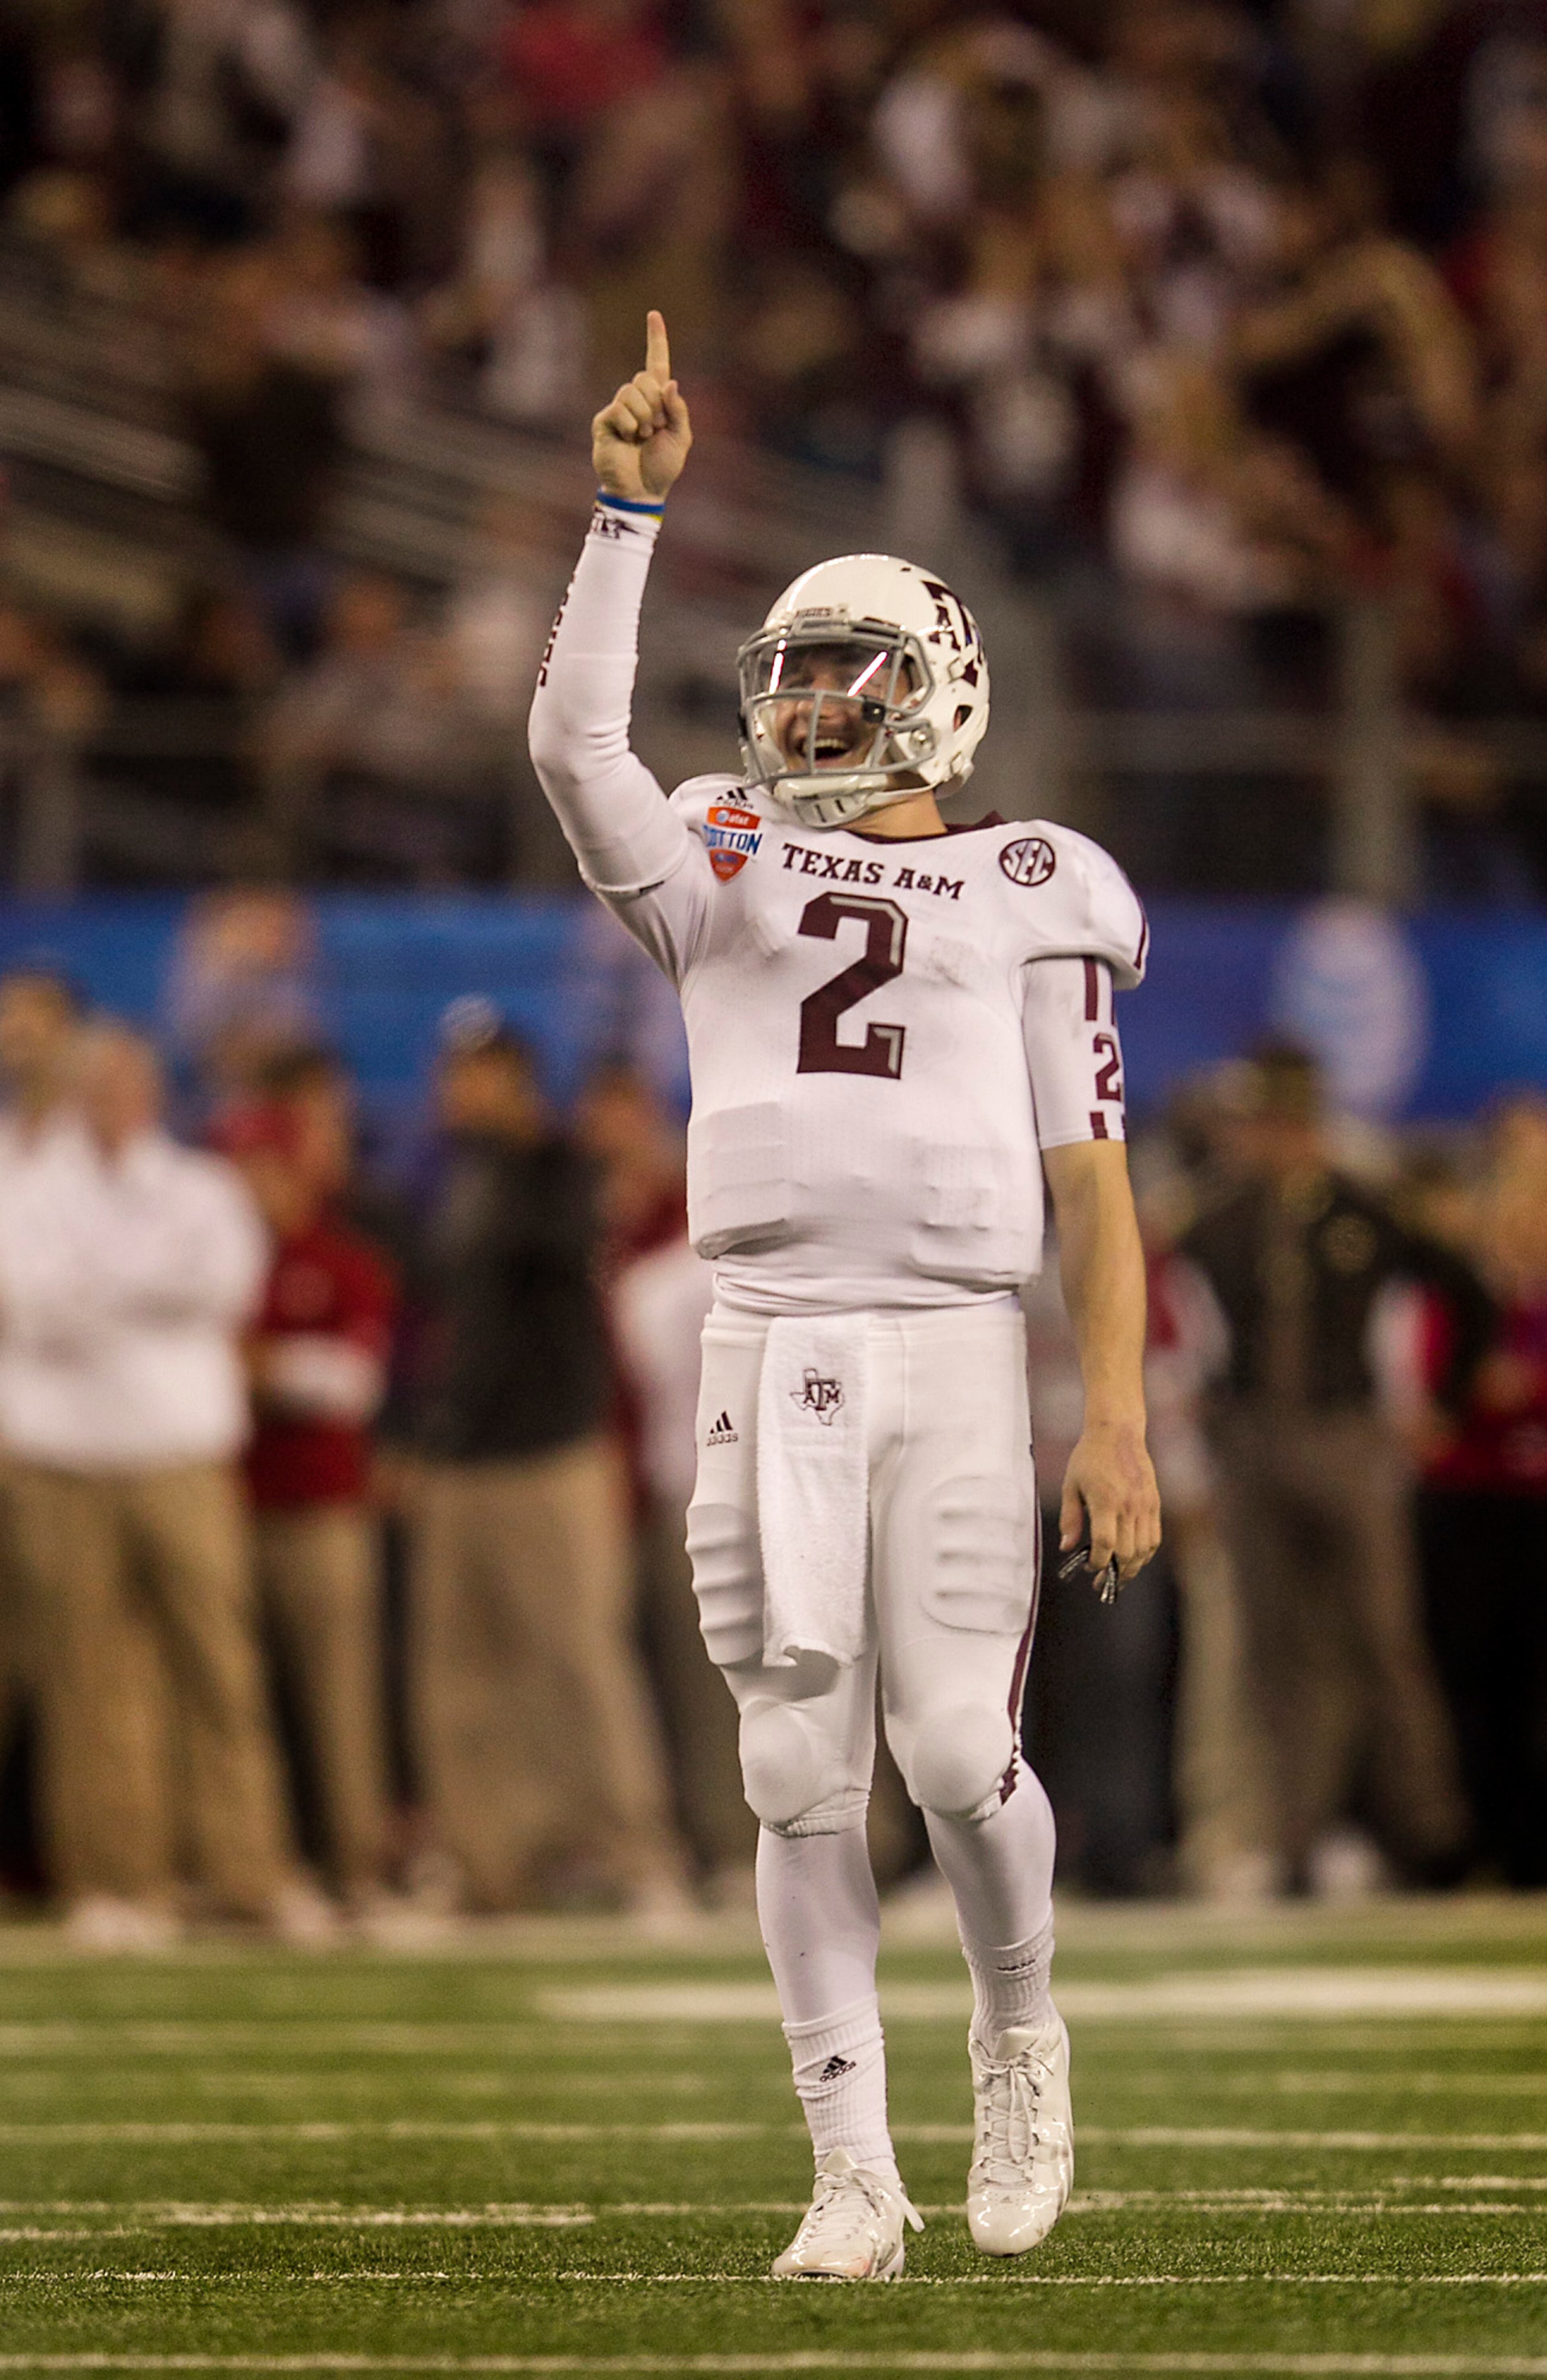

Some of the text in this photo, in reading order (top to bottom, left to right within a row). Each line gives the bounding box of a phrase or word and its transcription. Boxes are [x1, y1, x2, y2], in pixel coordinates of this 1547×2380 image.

[782, 843, 964, 900] TEXAS A&M
[1002, 840, 1053, 884] SEC
[796, 891, 908, 1080] 2
[1093, 1032, 1124, 1102] 2
[819, 2061, 856, 2082] adidas
